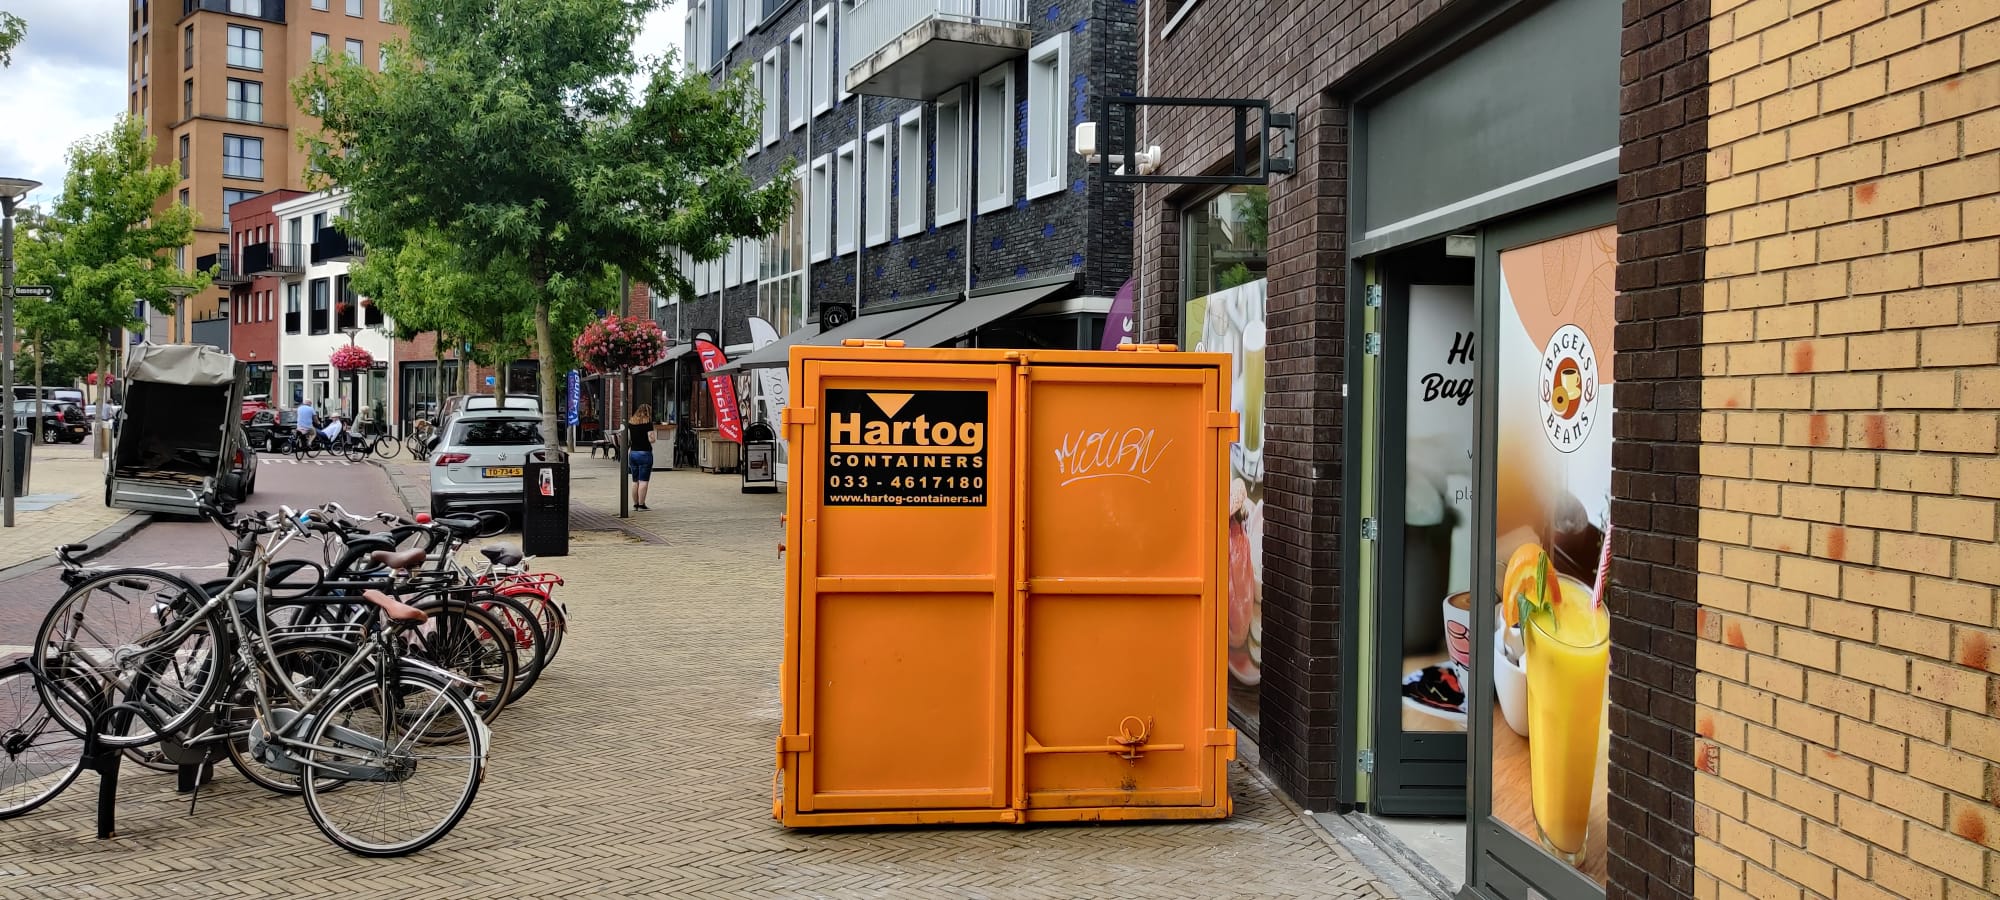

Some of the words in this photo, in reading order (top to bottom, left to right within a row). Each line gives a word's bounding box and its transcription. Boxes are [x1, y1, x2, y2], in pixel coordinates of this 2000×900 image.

[1545, 333, 1592, 372] BAGELS
[830, 412, 984, 454] Hartog
[1546, 411, 1589, 444] BEANS
[829, 454, 984, 468] CONTAINERS
[829, 475, 869, 488] 033
[889, 475, 984, 489] 4617180
[829, 493, 984, 505] www.hartog-containers.nl
